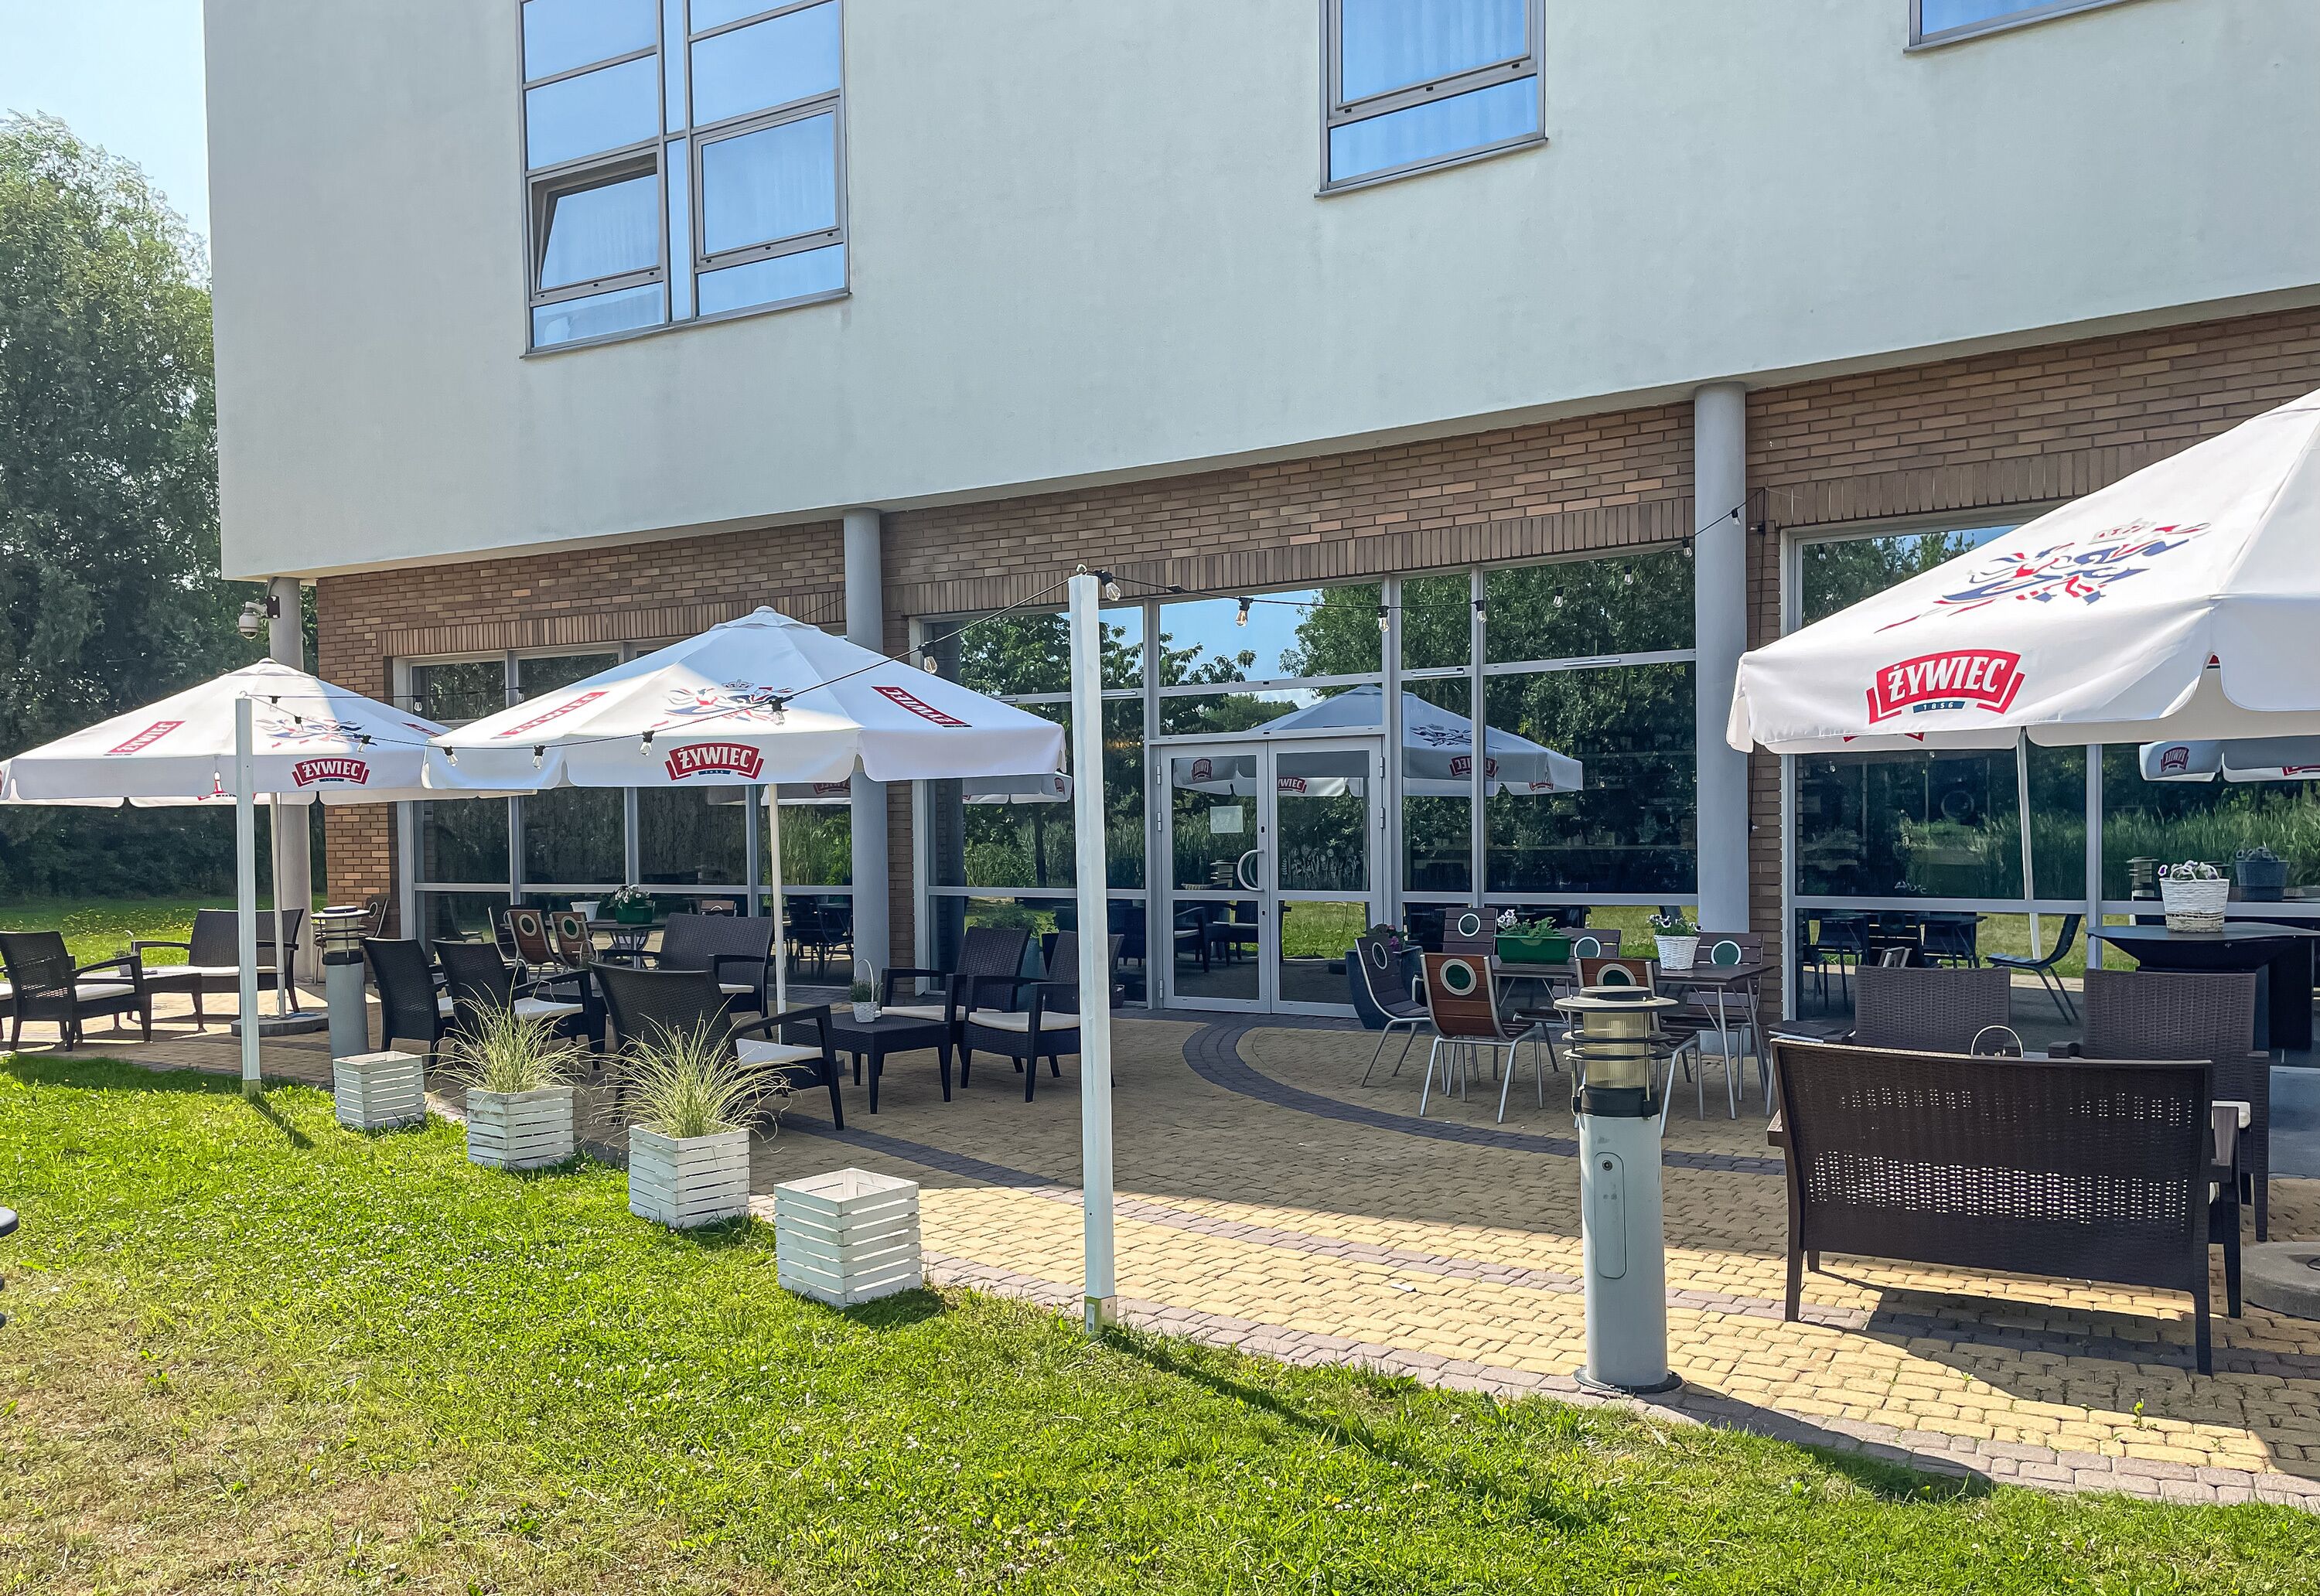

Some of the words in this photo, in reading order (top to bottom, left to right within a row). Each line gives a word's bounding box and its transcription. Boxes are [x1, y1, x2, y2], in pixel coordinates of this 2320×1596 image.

[1888, 656, 2008, 703] ŻYWIEC
[1923, 701, 1954, 711] 1856
[677, 746, 752, 770] ŻYWIEC
[302, 760, 360, 778] ŻYWIEC
